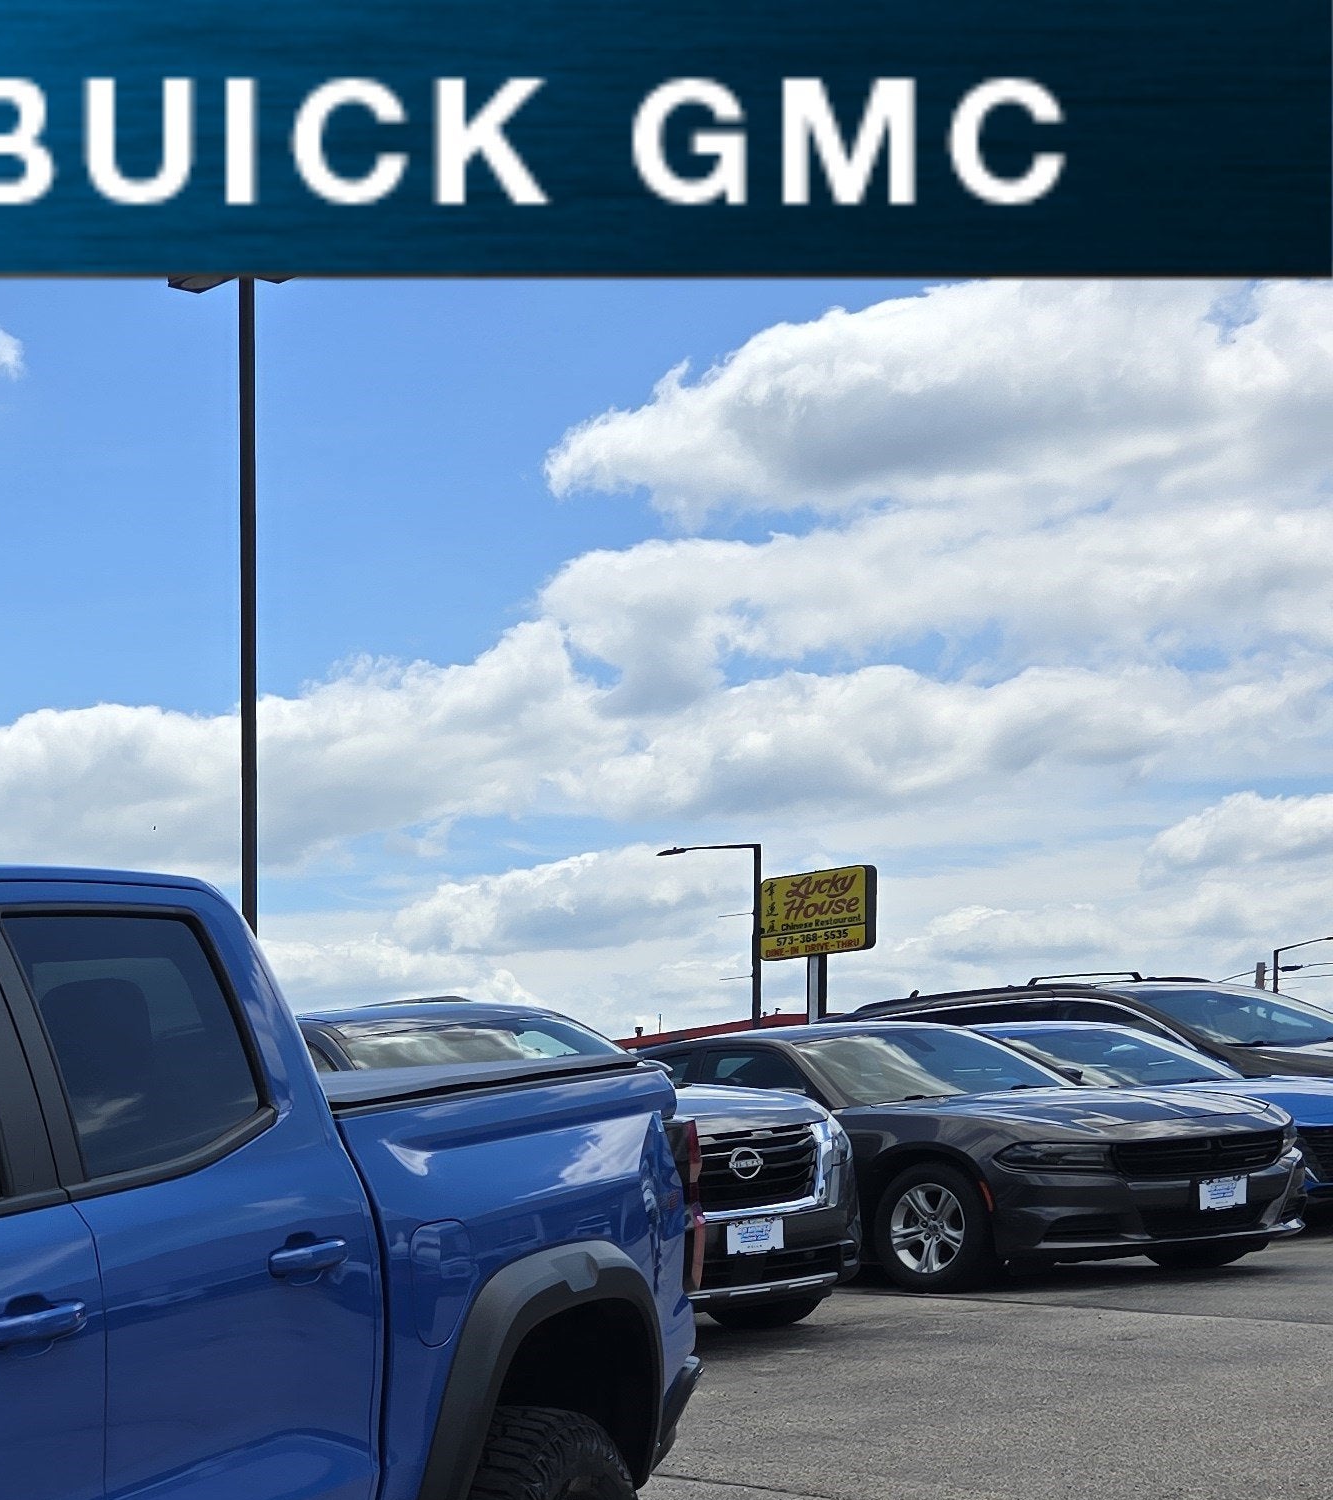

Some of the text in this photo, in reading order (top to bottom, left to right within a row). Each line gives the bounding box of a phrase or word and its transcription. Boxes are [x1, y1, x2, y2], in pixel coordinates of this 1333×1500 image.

[785, 873, 857, 899] Lucky
[783, 896, 860, 920] House
[781, 914, 862, 932] Chinese Restaurant
[765, 938, 860, 958] DINE-IN DRIVE-THRU
